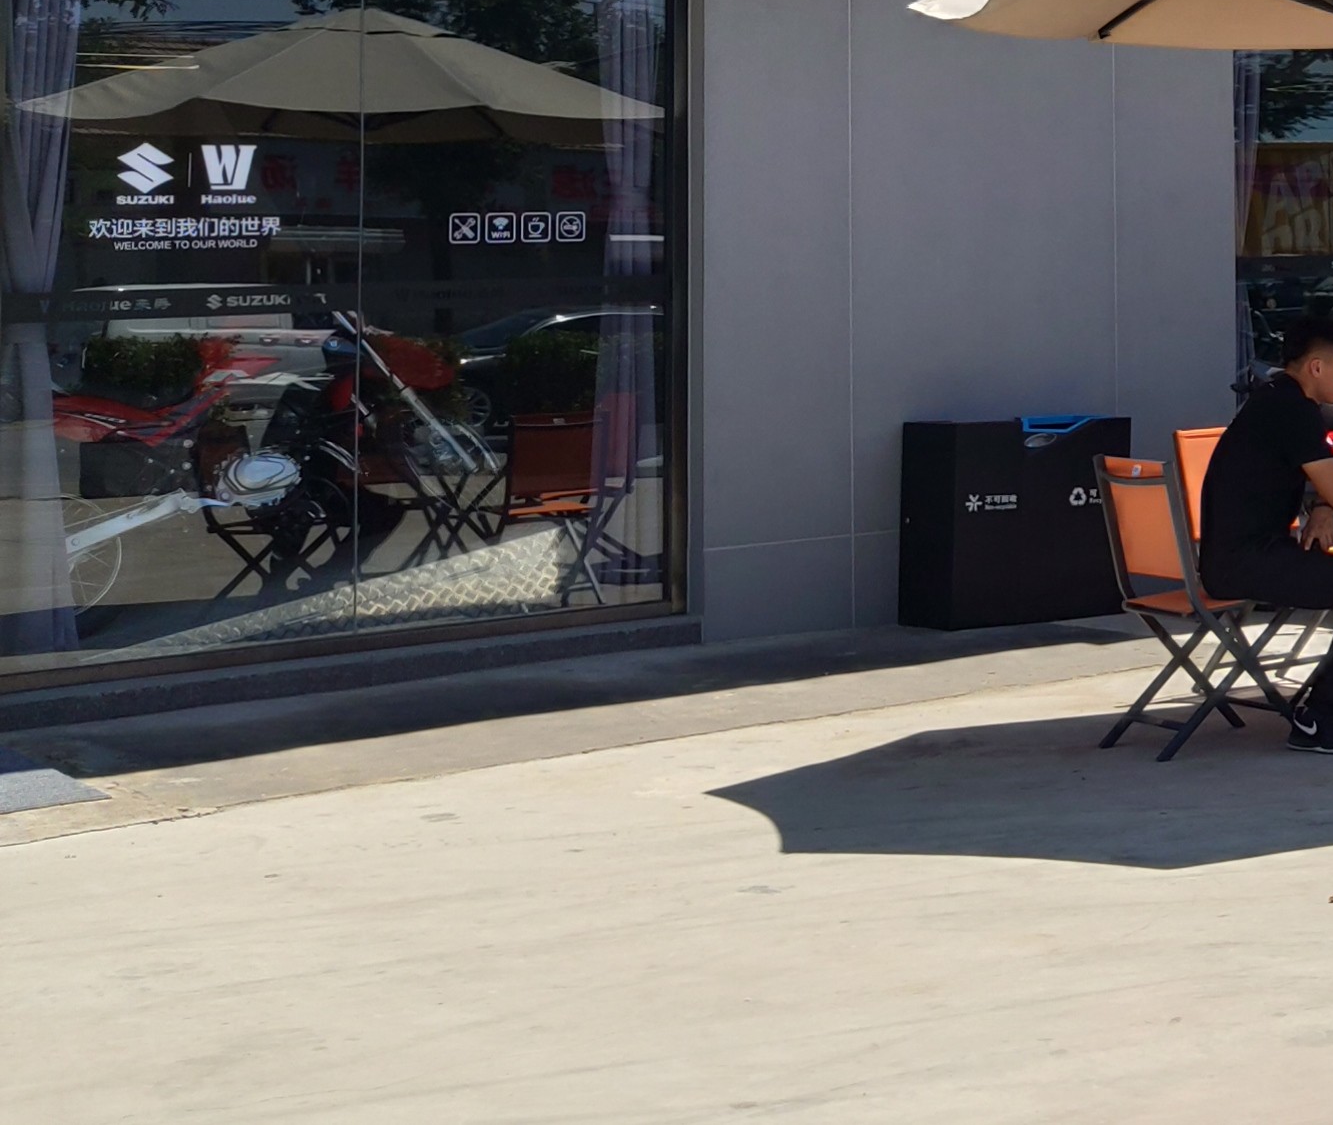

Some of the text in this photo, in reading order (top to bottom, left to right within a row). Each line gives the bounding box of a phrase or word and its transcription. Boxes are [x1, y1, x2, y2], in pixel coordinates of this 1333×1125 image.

[116, 194, 257, 205] SUZUKI Haojue
[89, 217, 281, 239] 欢迎来到我们的世界
[114, 238, 257, 251] WELCOME TO OUR WORLD
